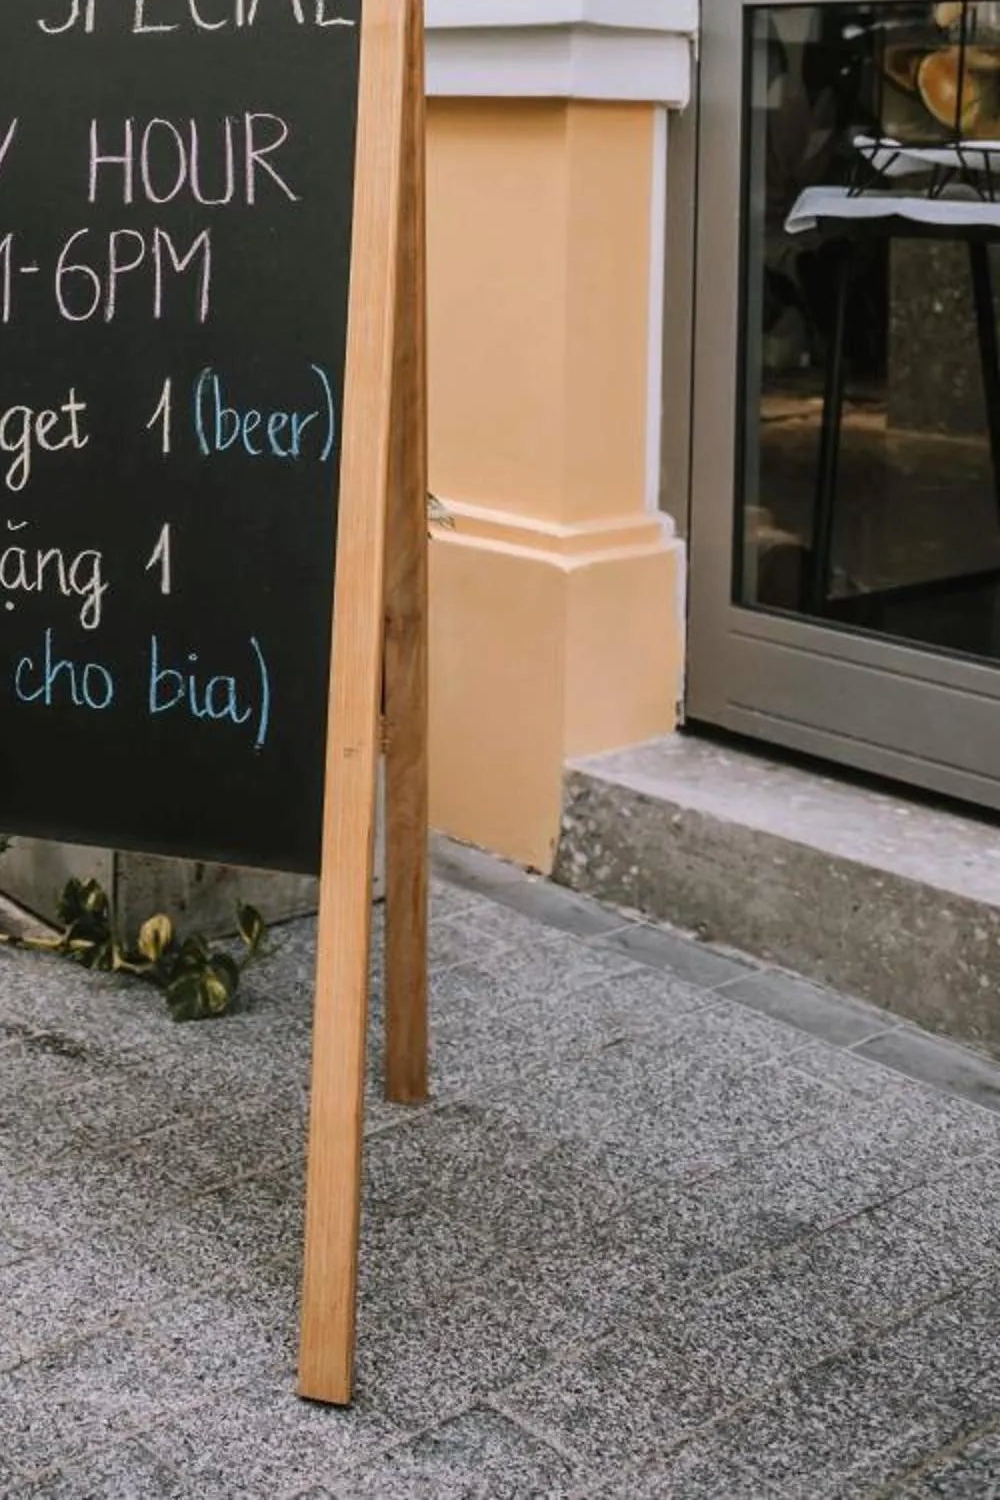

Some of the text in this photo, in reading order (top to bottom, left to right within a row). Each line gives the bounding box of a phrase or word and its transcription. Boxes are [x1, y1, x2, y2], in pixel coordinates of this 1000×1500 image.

[89, 111, 298, 205] HOUR
[147, 378, 171, 453] 1
[195, 364, 334, 461] (beer)
[146, 524, 170, 595] 1
[16, 628, 114, 709] cho
[150, 636, 269, 744] bia)
